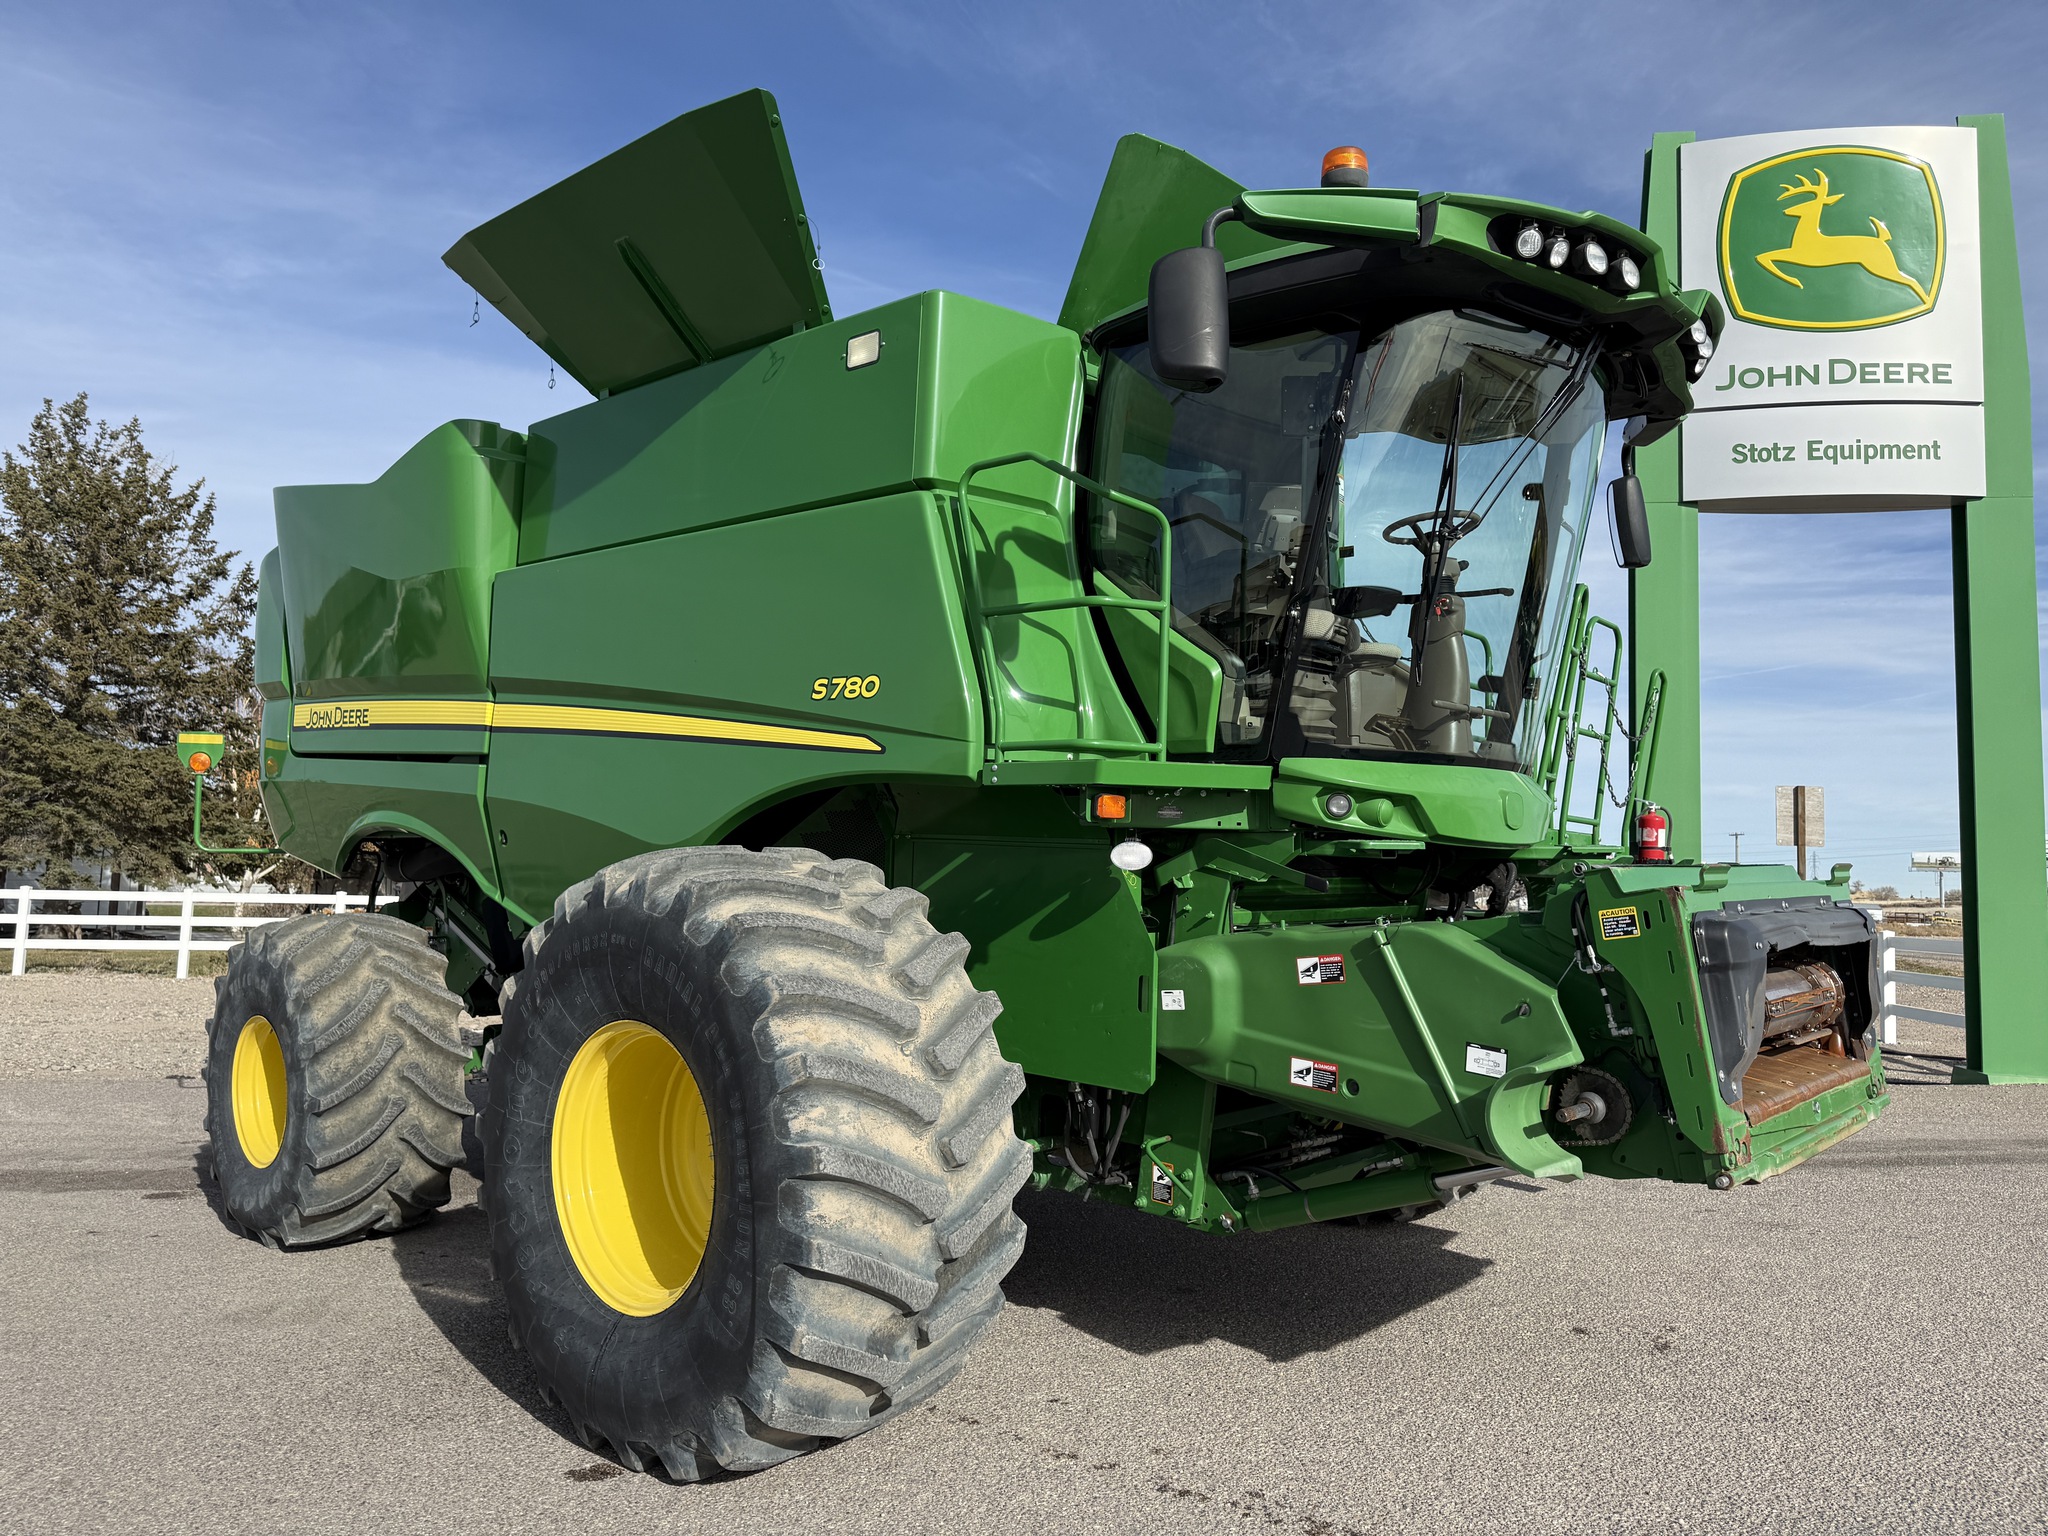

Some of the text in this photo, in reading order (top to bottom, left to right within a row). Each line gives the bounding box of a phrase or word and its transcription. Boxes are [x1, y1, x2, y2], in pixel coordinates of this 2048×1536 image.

[1715, 358, 1953, 392] JOHN DEERE
[1731, 438, 1942, 466] Stotz Equipment
[811, 674, 881, 701] S780
[305, 706, 370, 727] JOHN DEERE
[1606, 908, 1635, 916] CAUTION
[644, 946, 702, 1018] RADIAL
